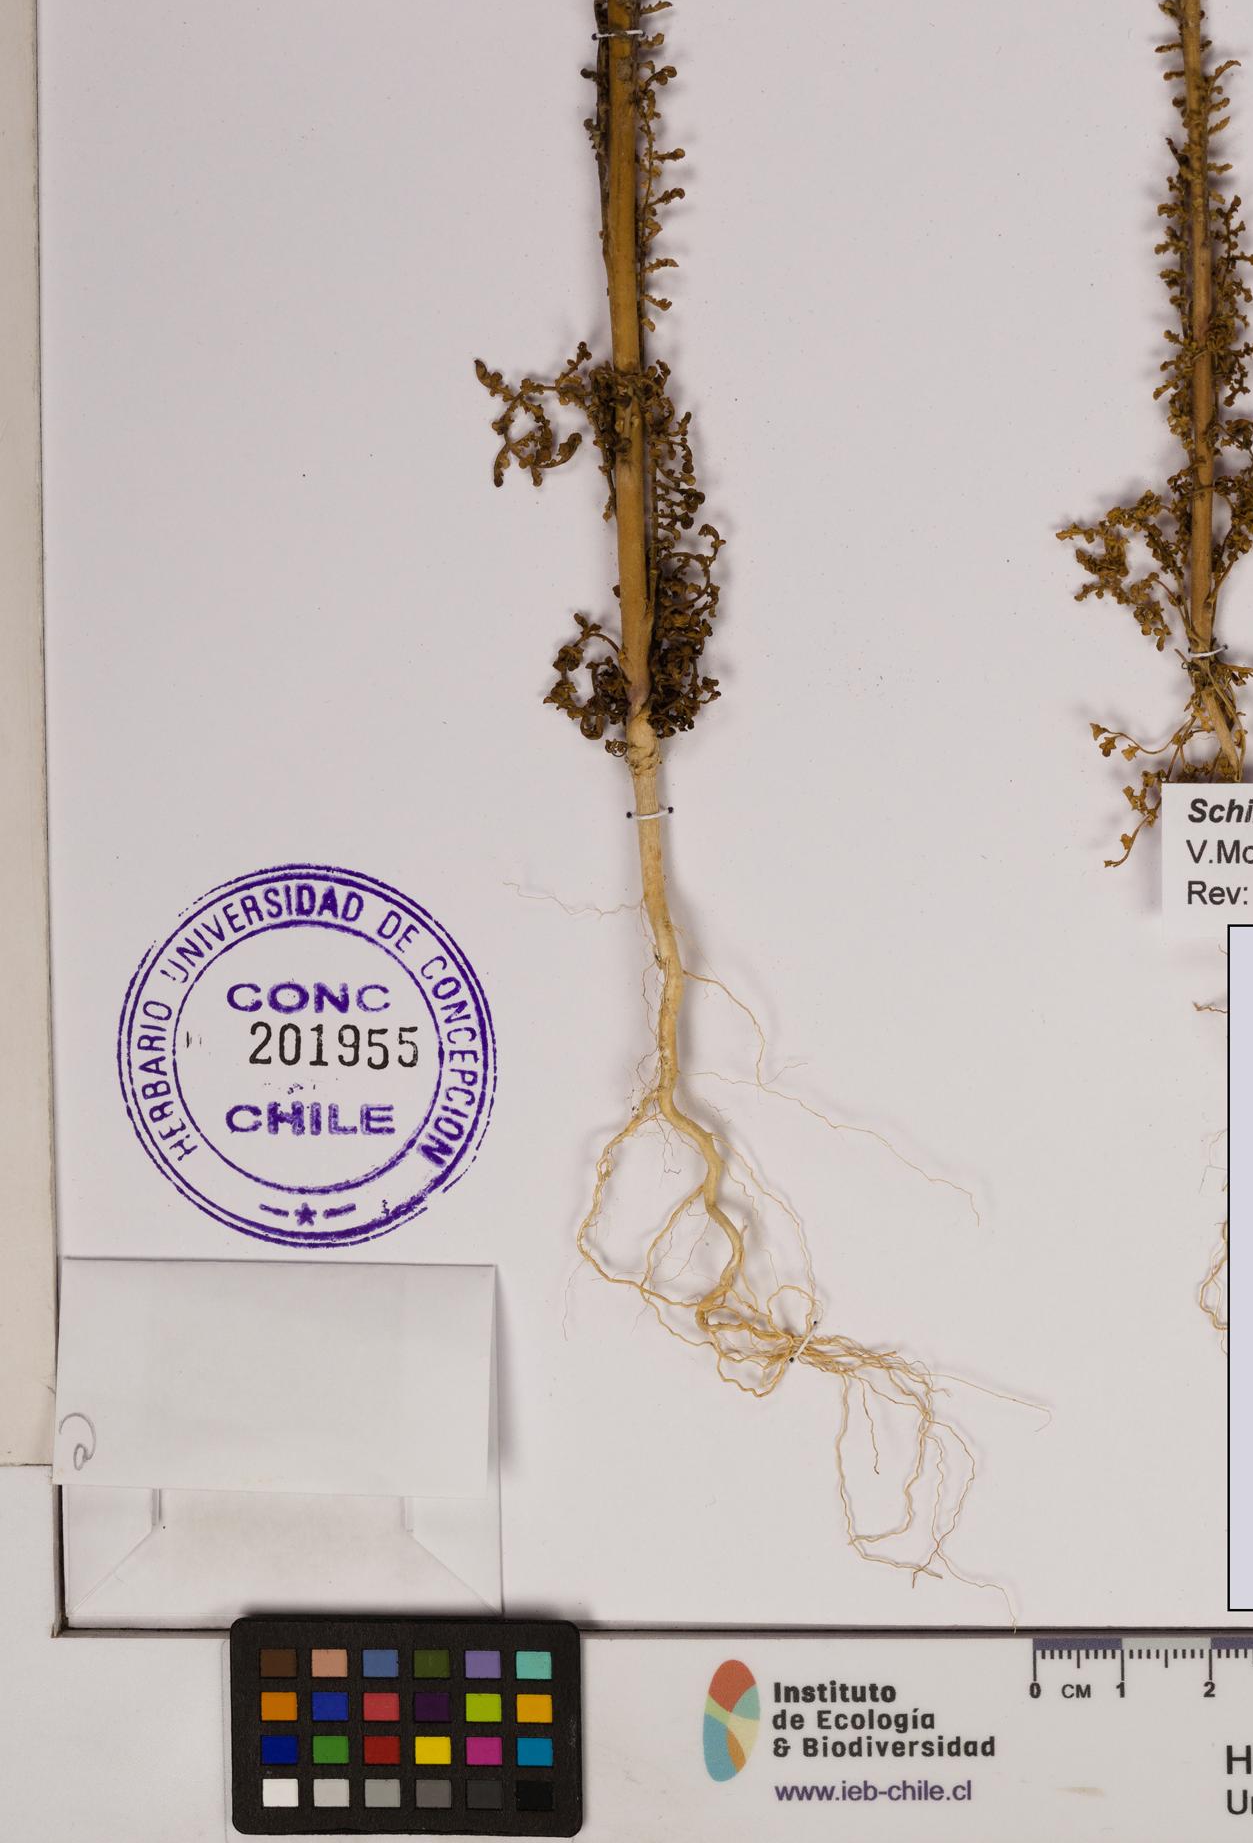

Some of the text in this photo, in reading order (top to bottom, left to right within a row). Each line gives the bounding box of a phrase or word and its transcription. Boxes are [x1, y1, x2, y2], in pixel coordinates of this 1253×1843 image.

[1188, 881, 1247, 905] Rev:
[226, 982, 390, 1013] CONC
[137, 882, 478, 1168] HERBARIO UNIVERSIDAD DE CONCEPCION
[249, 1021, 418, 1069] 201955
[225, 1100, 395, 1135] CHILE
[774, 1680, 896, 1703] Instituto
[1030, 1683, 1041, 1698] 0
[1062, 1684, 1091, 1698] CM
[1116, 1682, 1125, 1698] 1
[1204, 1682, 1215, 1697] 2
[773, 1708, 934, 1733] de Ecología
[773, 1736, 994, 1757] & Biodiversidad
[775, 1780, 971, 1801] www.ieb-chile.cl
